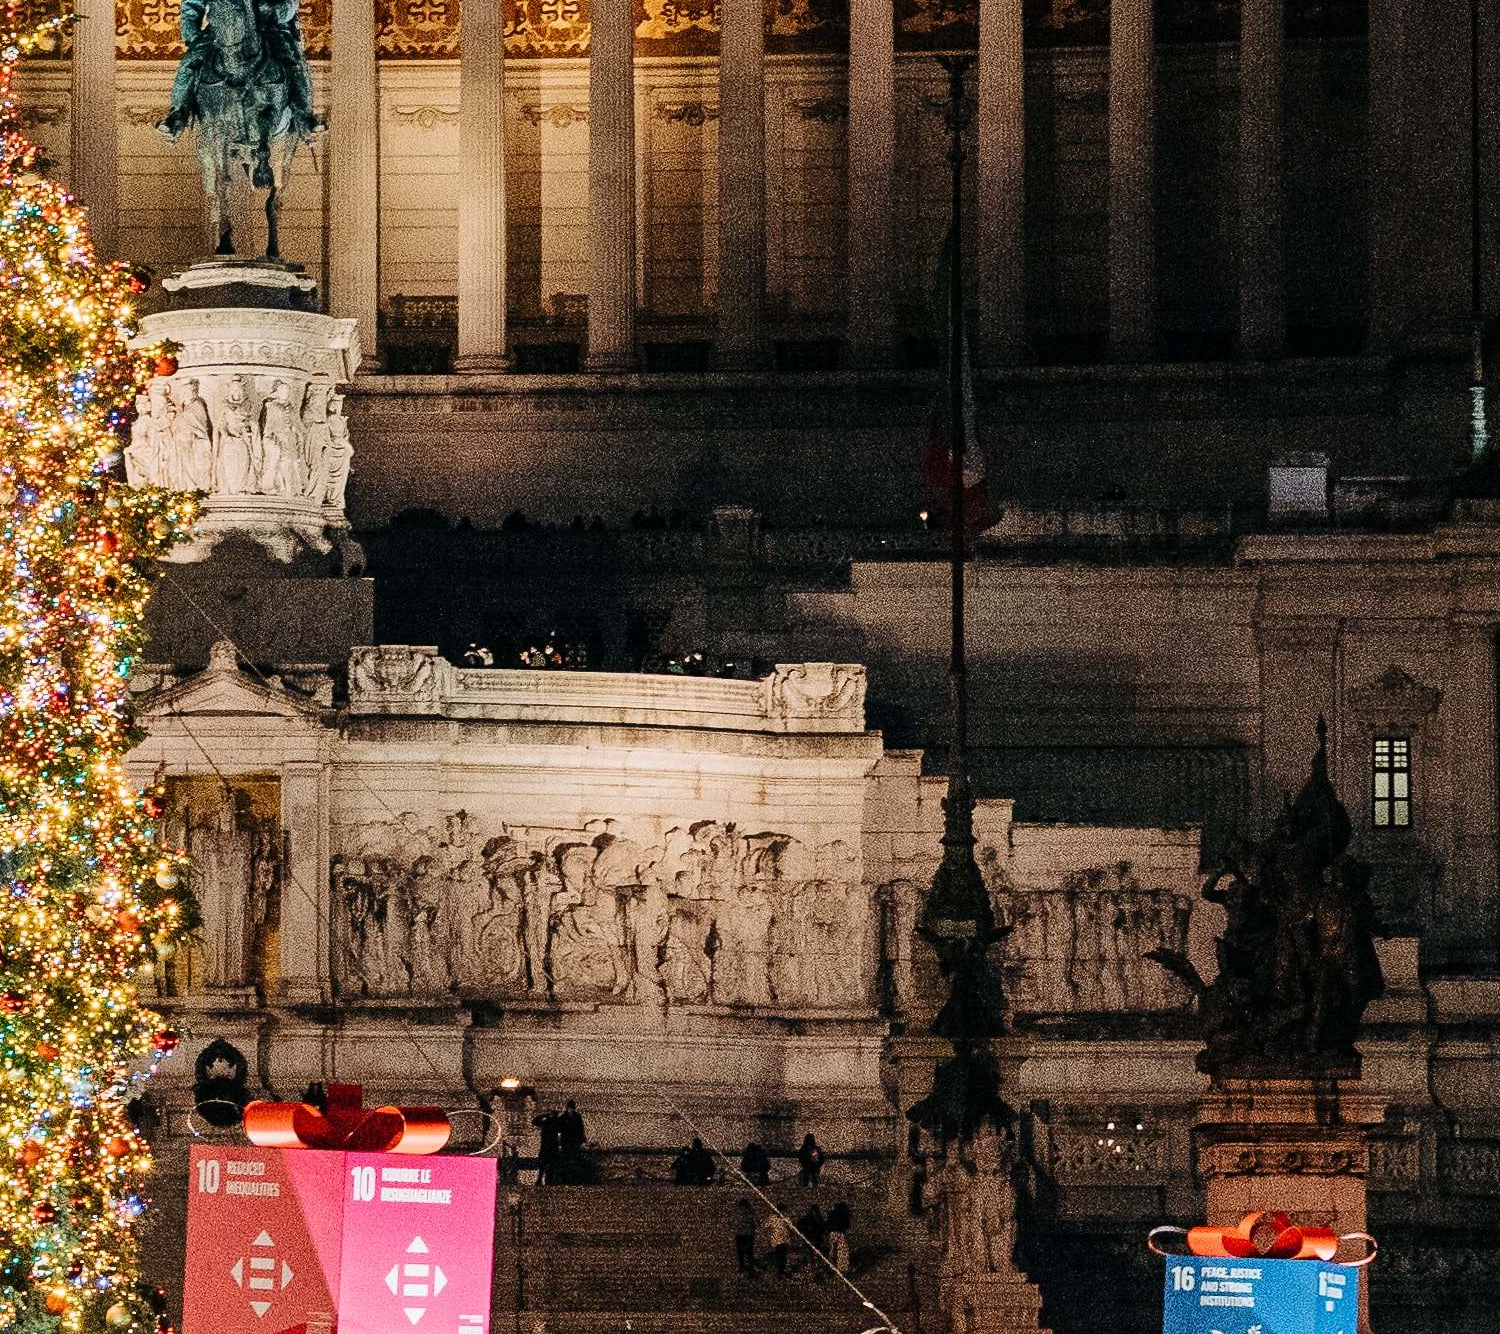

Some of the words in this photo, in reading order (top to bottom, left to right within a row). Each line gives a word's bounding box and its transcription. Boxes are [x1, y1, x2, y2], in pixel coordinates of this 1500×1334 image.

[197, 1159, 220, 1194] 10
[351, 1166, 376, 1201] 10
[421, 1169, 432, 1183] LE
[1171, 1266, 1195, 1291] 16
